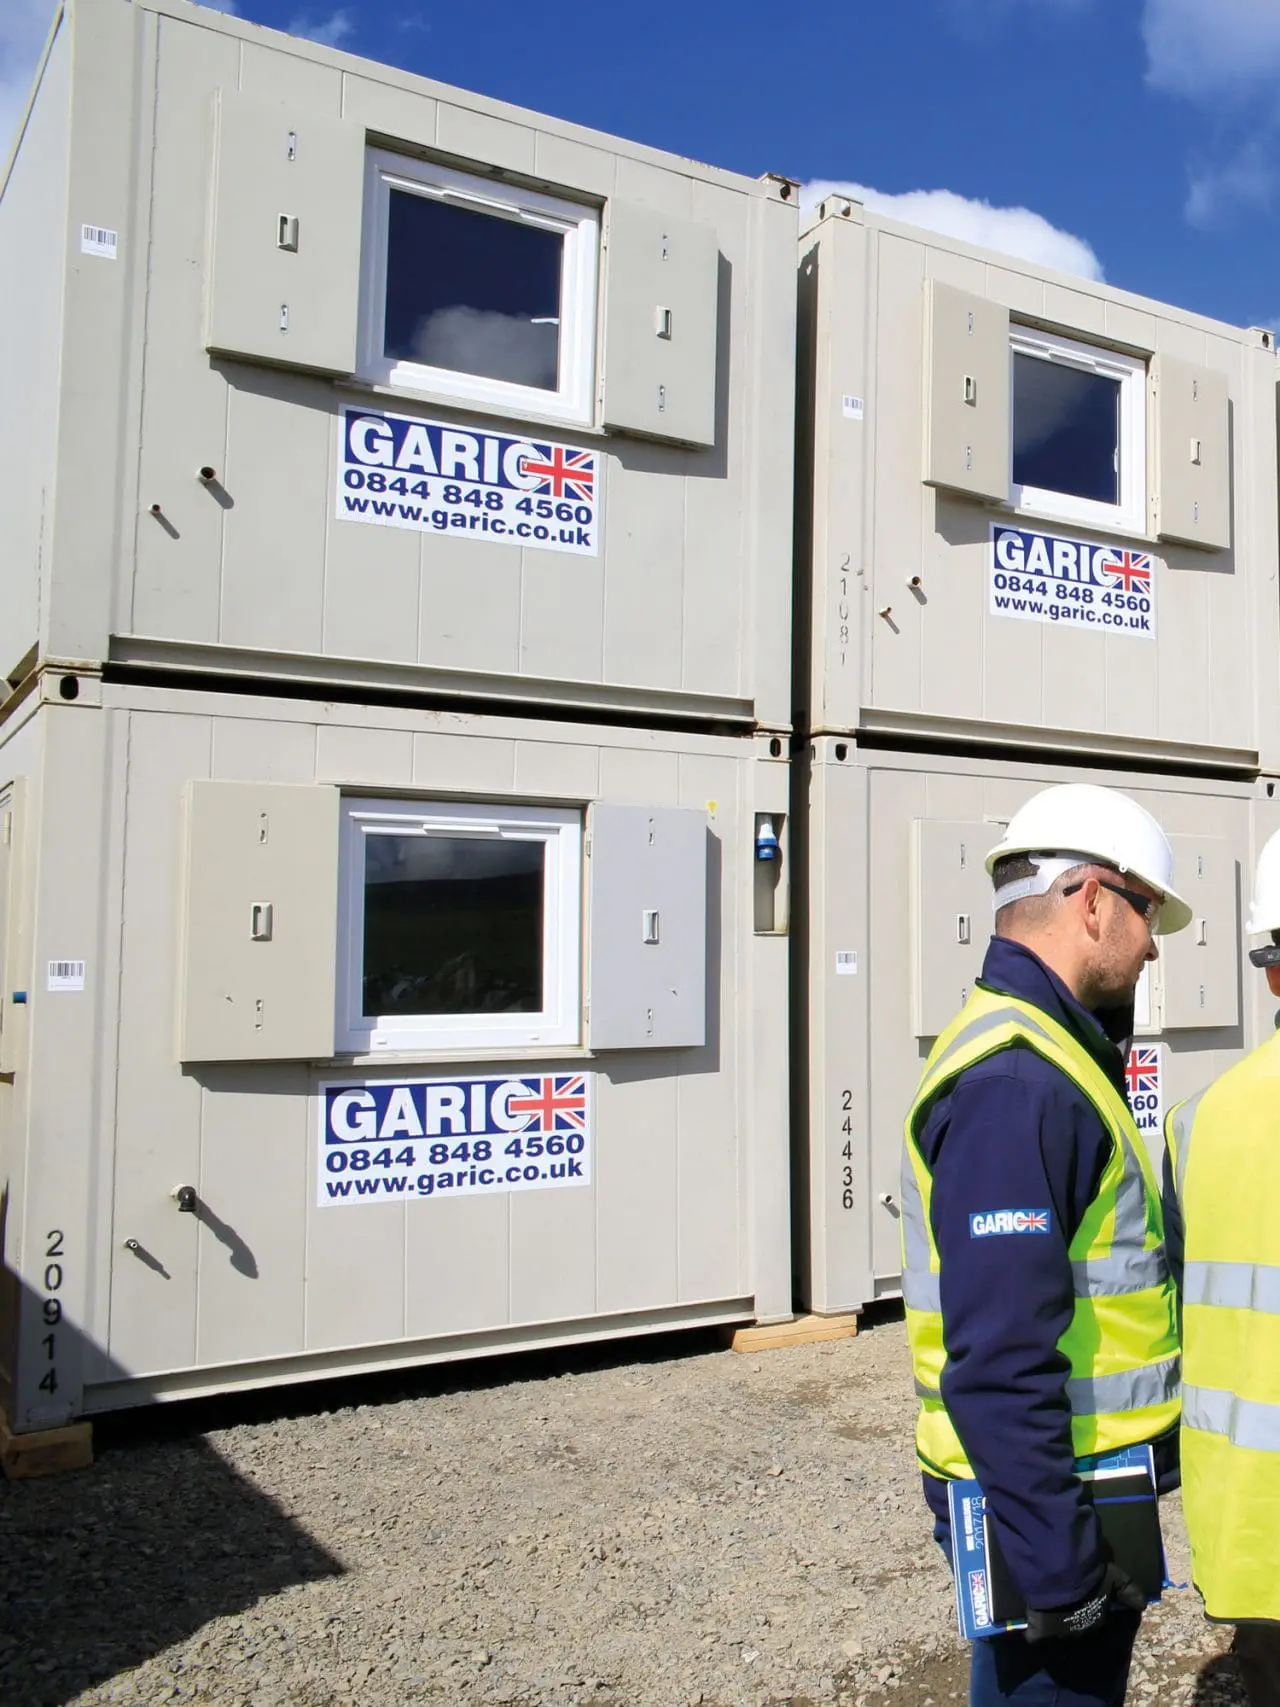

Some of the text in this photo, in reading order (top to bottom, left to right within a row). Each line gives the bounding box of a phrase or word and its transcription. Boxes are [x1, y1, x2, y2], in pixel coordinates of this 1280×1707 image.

[350, 416, 543, 491] GARIC
[344, 469, 593, 525] 0844 848 4560
[344, 496, 591, 546] www.garic.co.uk
[997, 531, 1120, 587] GARIC
[994, 573, 1151, 613] 0844 848 4560
[995, 595, 1150, 630] www.garic.co.uk
[330, 1081, 532, 1142] GARIC
[1128, 1094, 1158, 1111] 60
[326, 1134, 585, 1173] 0844 848 4560
[841, 1090, 853, 1209] 24436
[326, 1158, 583, 1197] www.garic.co.uk
[973, 1211, 1026, 1235] GARIC
[38, 1230, 64, 1395] 20914
[972, 1584, 989, 1626] GARIC
